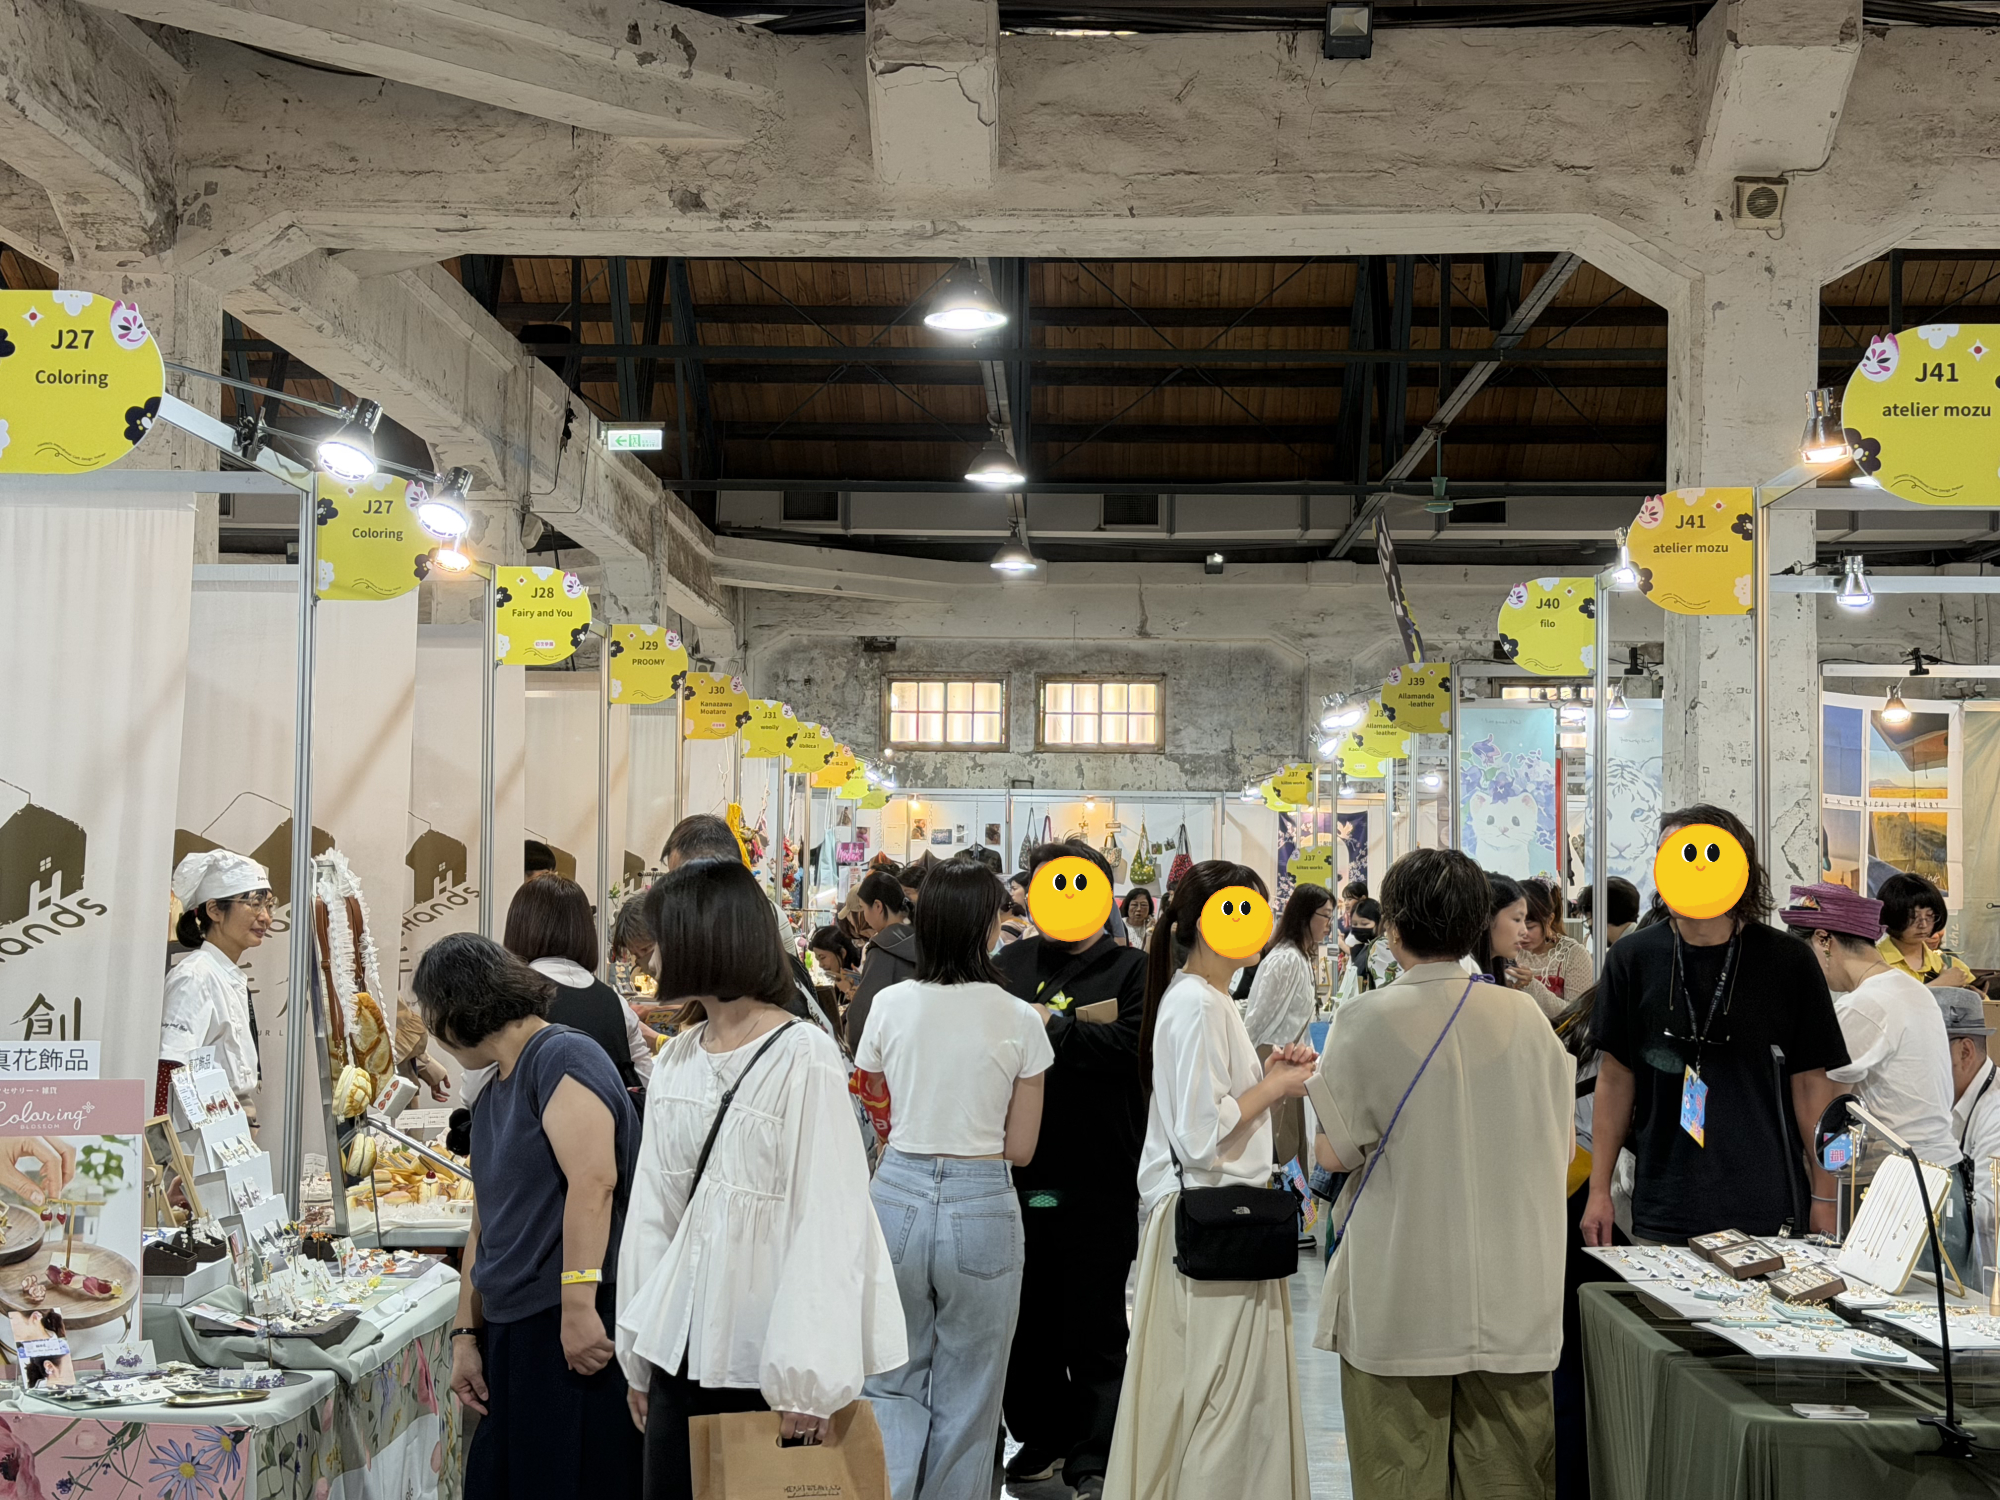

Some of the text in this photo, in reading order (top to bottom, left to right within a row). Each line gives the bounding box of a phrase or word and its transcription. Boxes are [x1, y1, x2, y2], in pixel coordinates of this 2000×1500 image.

[50, 329, 95, 350] J27
[35, 369, 109, 388] Coloring
[1914, 362, 1959, 383] J41
[1882, 402, 1991, 418] atelier mozu
[362, 499, 393, 515] J27
[1675, 514, 1706, 529] J41
[351, 527, 404, 542] Coloring
[1653, 542, 1729, 554] atelier mozu
[531, 587, 555, 599] J28
[1536, 598, 1561, 610] J40
[512, 608, 573, 620] Fairy and You
[1539, 618, 1556, 628] filo
[638, 641, 659, 651] J29
[632, 658, 666, 666] PROOMY
[1407, 677, 1425, 686] J39
[708, 686, 725, 695] J30
[763, 711, 777, 719] J31
[1374, 709, 1387, 717] J3
[0, 897, 108, 963] ands
